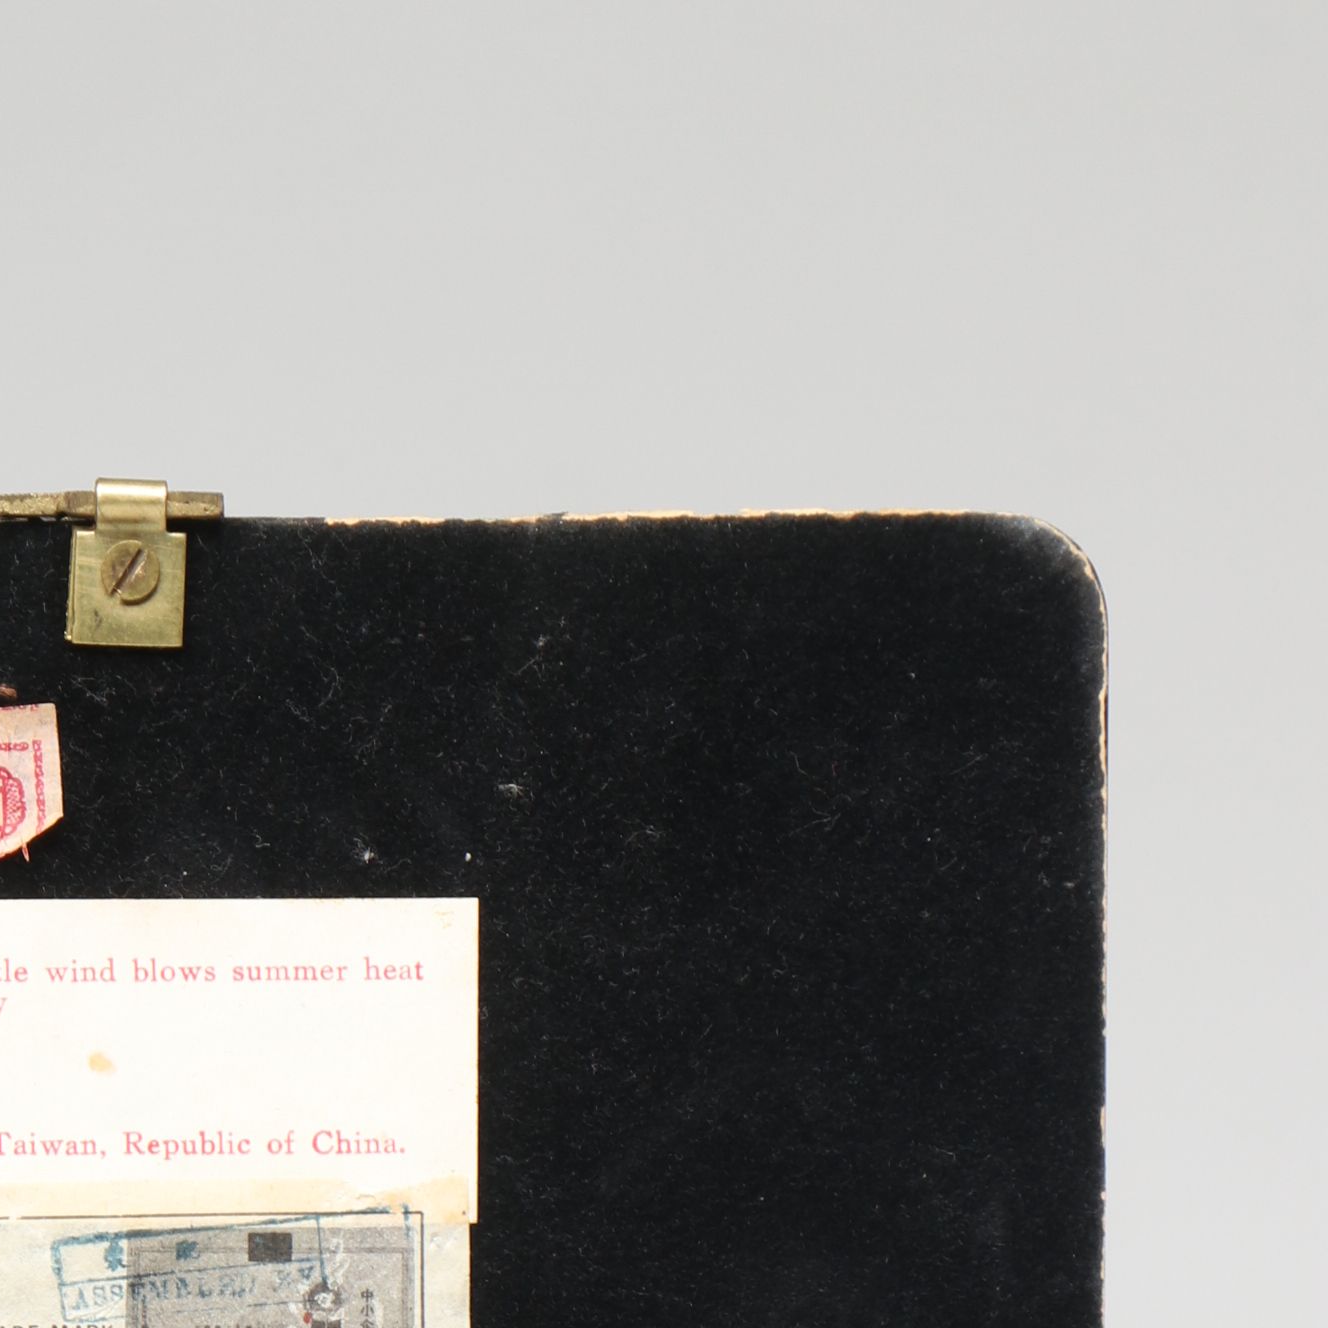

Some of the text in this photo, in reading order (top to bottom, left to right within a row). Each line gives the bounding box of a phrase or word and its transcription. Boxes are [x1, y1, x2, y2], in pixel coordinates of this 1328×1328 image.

[45, 957, 116, 983] wind
[132, 957, 217, 983] blows
[232, 965, 348, 982] summer
[364, 956, 424, 981] heat
[122, 1130, 251, 1161] Republic
[266, 1130, 294, 1155] of
[311, 1129, 406, 1156] China.
